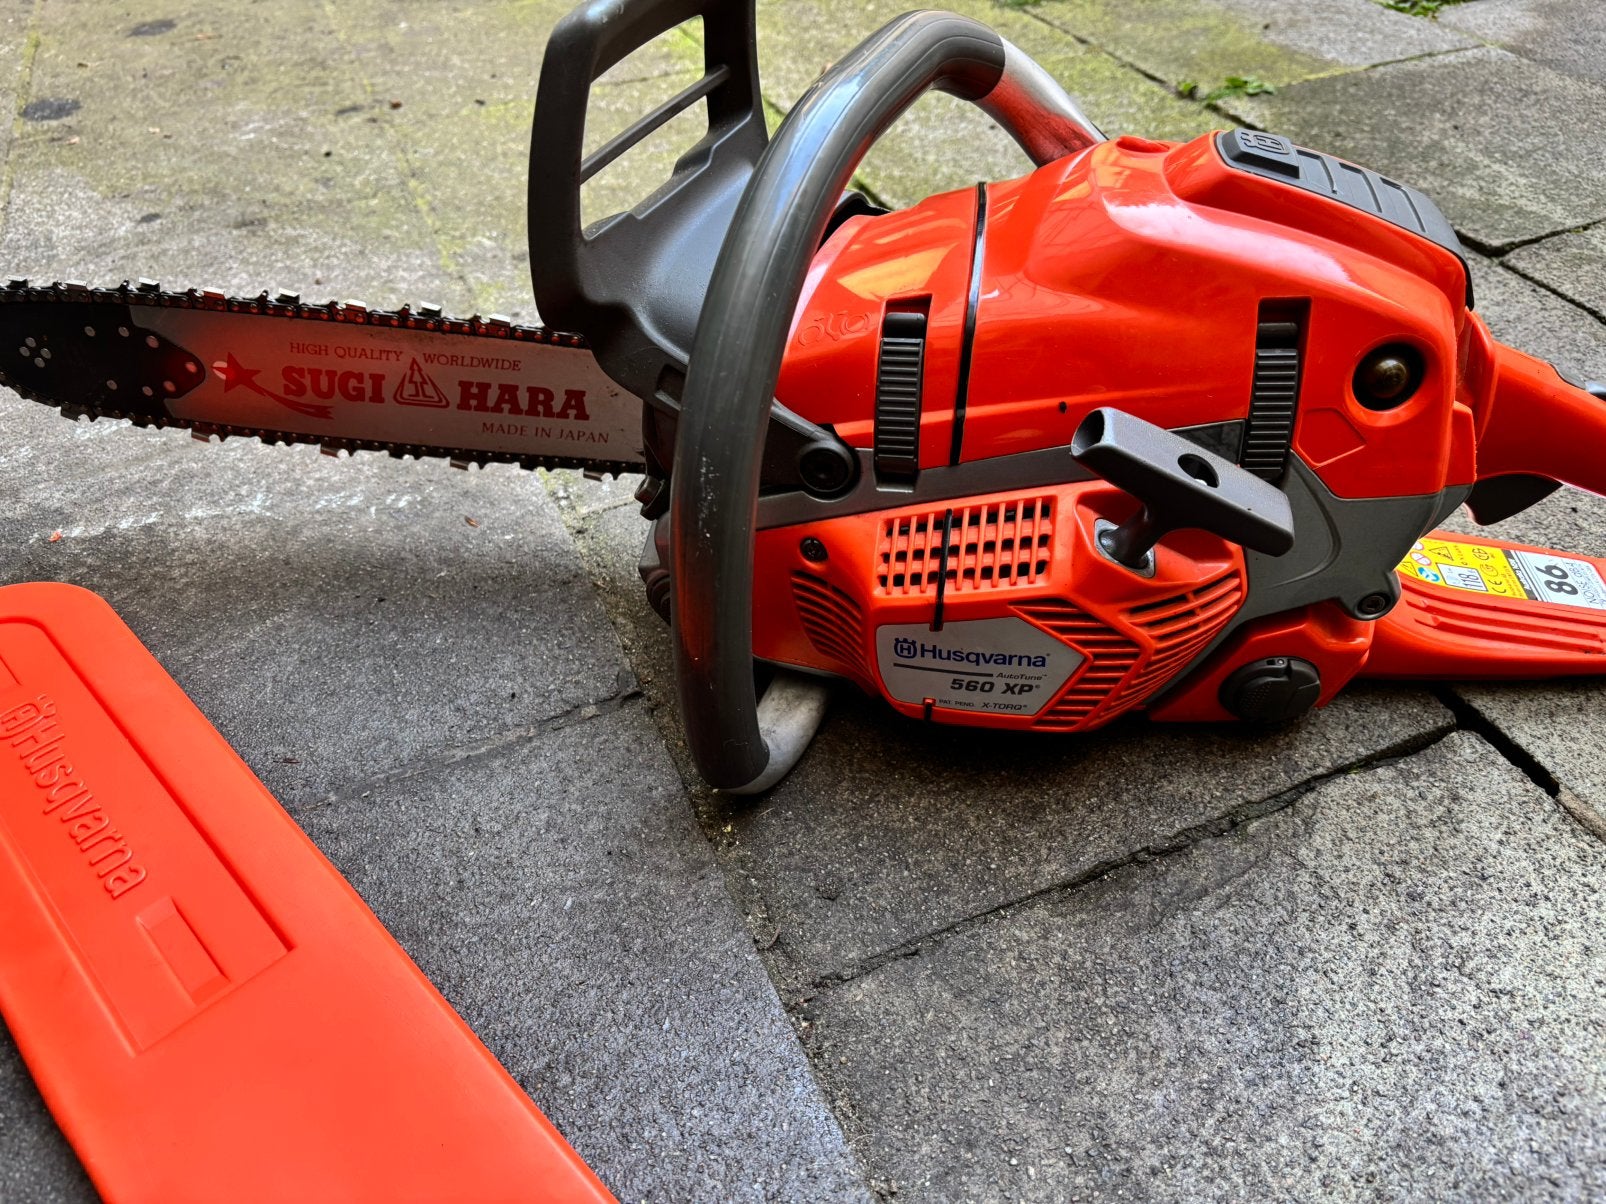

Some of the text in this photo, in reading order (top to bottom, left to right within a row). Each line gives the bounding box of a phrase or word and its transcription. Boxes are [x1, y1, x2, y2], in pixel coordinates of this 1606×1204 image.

[290, 342, 522, 371] HIGH QUALITY WORLDWIDE
[282, 366, 590, 421] SUGI HARA
[482, 422, 609, 444] MADE IN JAPAN
[1534, 564, 1578, 596] 86
[920, 643, 1046, 667] Husqvarna
[950, 678, 995, 693] 560
[11, 722, 147, 900] Husqvarna
